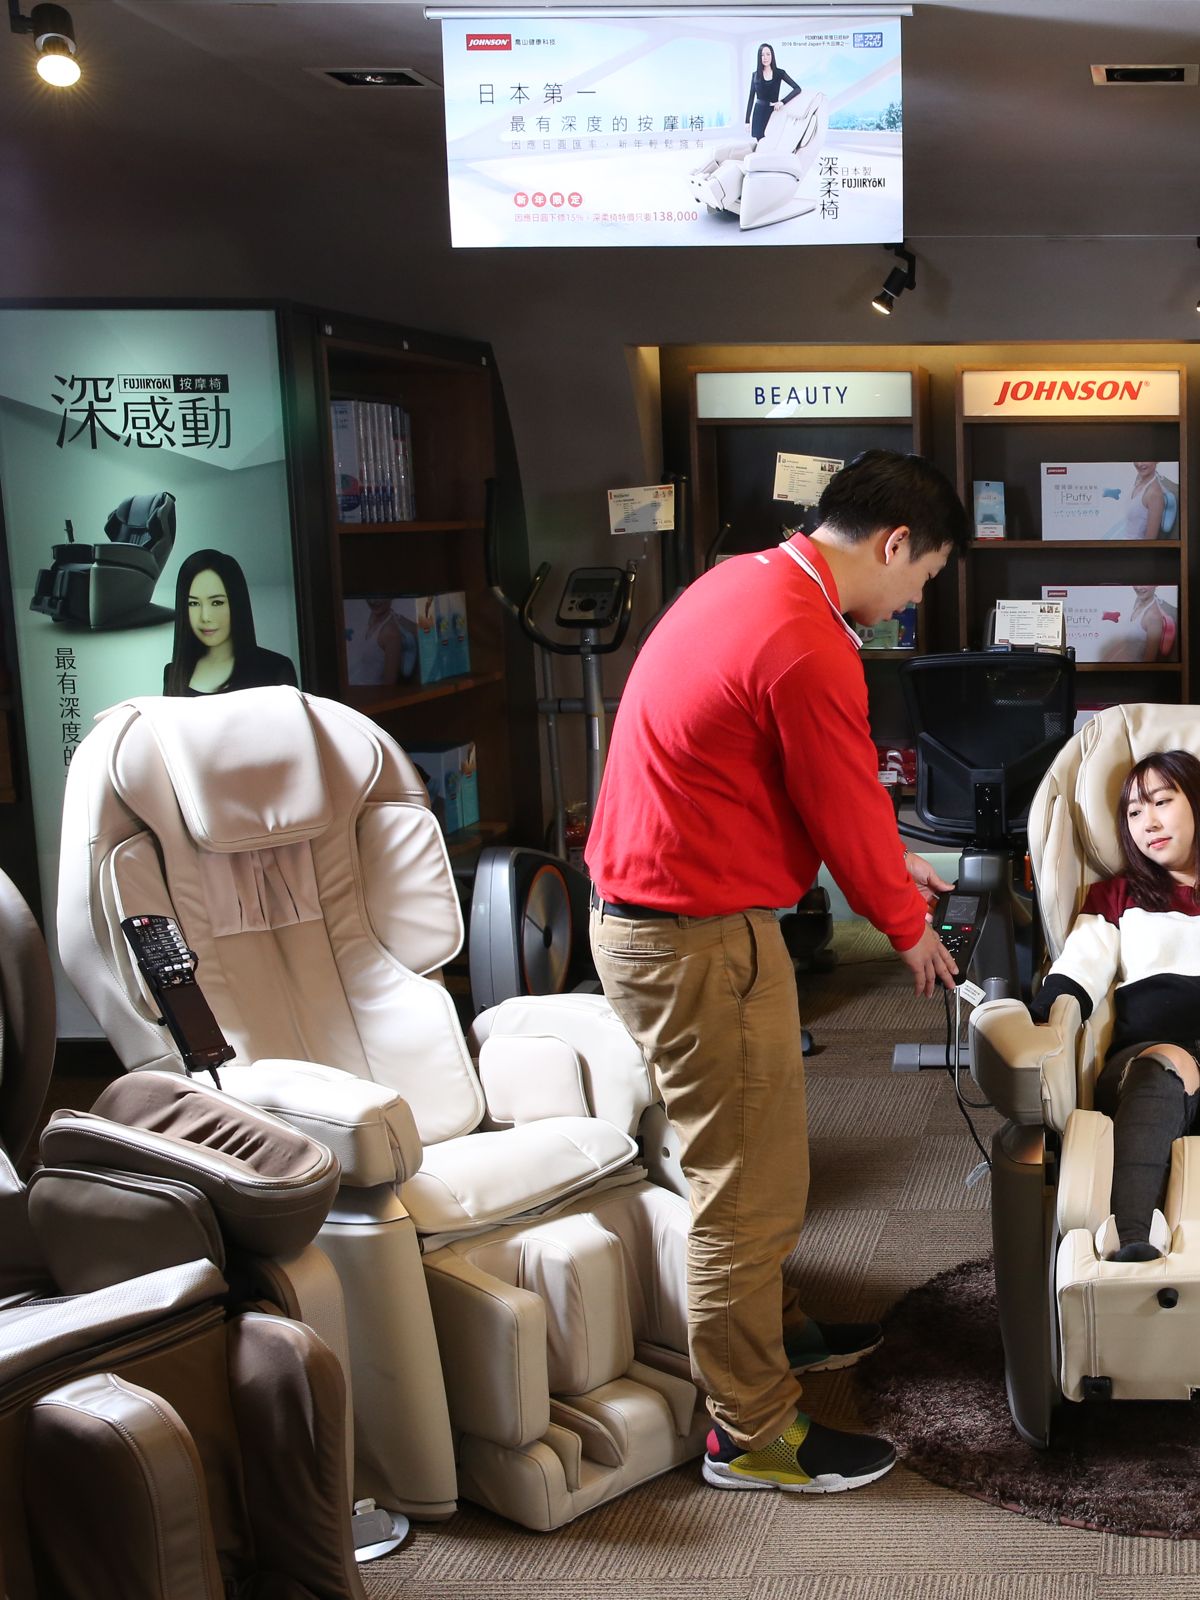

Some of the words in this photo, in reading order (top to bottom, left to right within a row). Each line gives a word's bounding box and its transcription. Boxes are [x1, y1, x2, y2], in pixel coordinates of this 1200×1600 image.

[478, 83, 597, 105] 日本第一
[510, 115, 705, 132] 最有深度的按摩椅
[819, 156, 839, 220] 深柔椅
[515, 194, 582, 206] 新年限定
[179, 378, 221, 391] 按摩椅
[754, 386, 848, 405] BEAUTY
[51, 374, 232, 449] 深感動
[54, 647, 82, 770] 最有深度的
